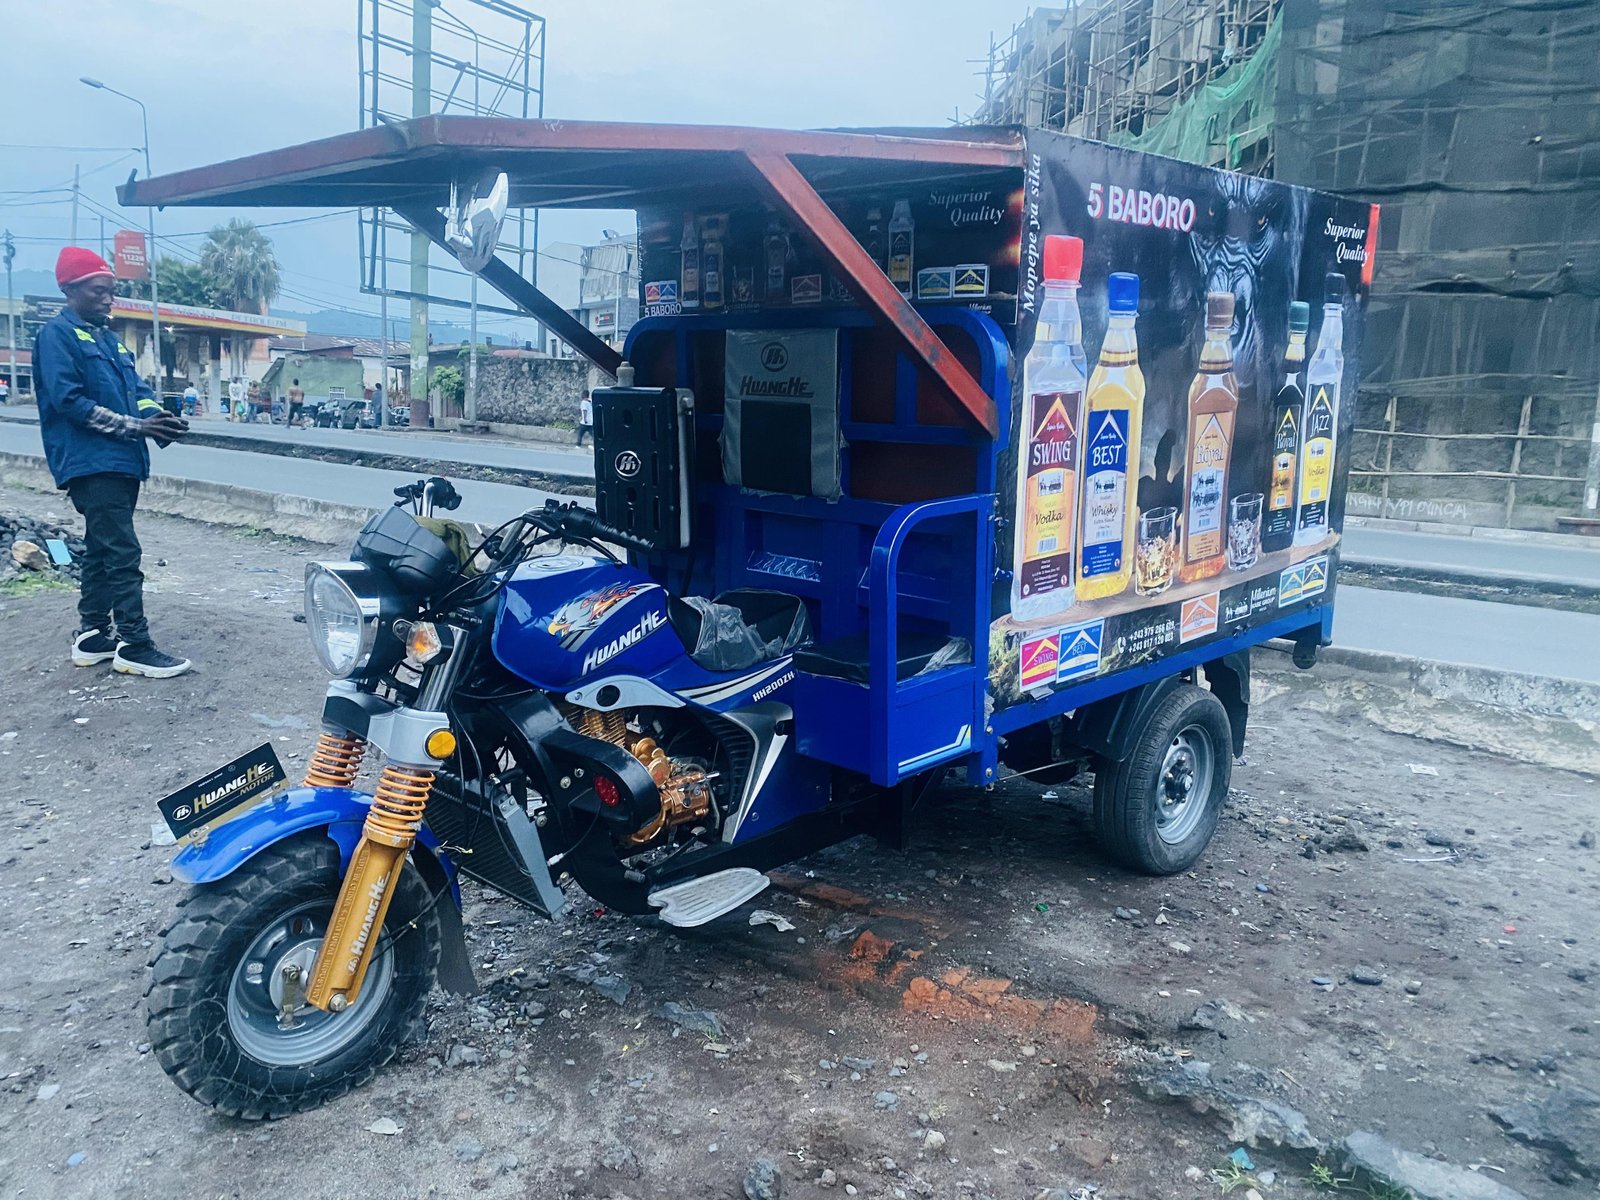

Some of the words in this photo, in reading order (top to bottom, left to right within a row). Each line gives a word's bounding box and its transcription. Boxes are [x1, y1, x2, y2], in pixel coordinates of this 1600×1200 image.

[1029, 154, 1041, 197] sika
[928, 188, 991, 209] Superior
[1087, 182, 1104, 219] 5
[1108, 185, 1196, 233] BABORO
[950, 205, 1005, 227] Quality
[1030, 203, 1041, 230] ya
[1324, 217, 1365, 242] Superior
[1336, 242, 1370, 268] Quality
[1023, 231, 1040, 314] Mopepe
[645, 307, 650, 317] 5
[651, 303, 682, 316] BABORO
[740, 376, 815, 398] HUANGHE
[1310, 414, 1330, 438] JAZZ
[1032, 438, 1071, 467] SWING
[1092, 444, 1123, 467] BEST
[1035, 510, 1064, 526] Vodka
[1091, 503, 1118, 517] Whisky
[582, 610, 668, 676] HUANGHE
[1072, 642, 1087, 656] BEST
[752, 670, 795, 702] HH200ZH
[194, 762, 274, 814] HUANGHE
[240, 771, 274, 796] MOTOR
[351, 871, 389, 954] HUANGHE
